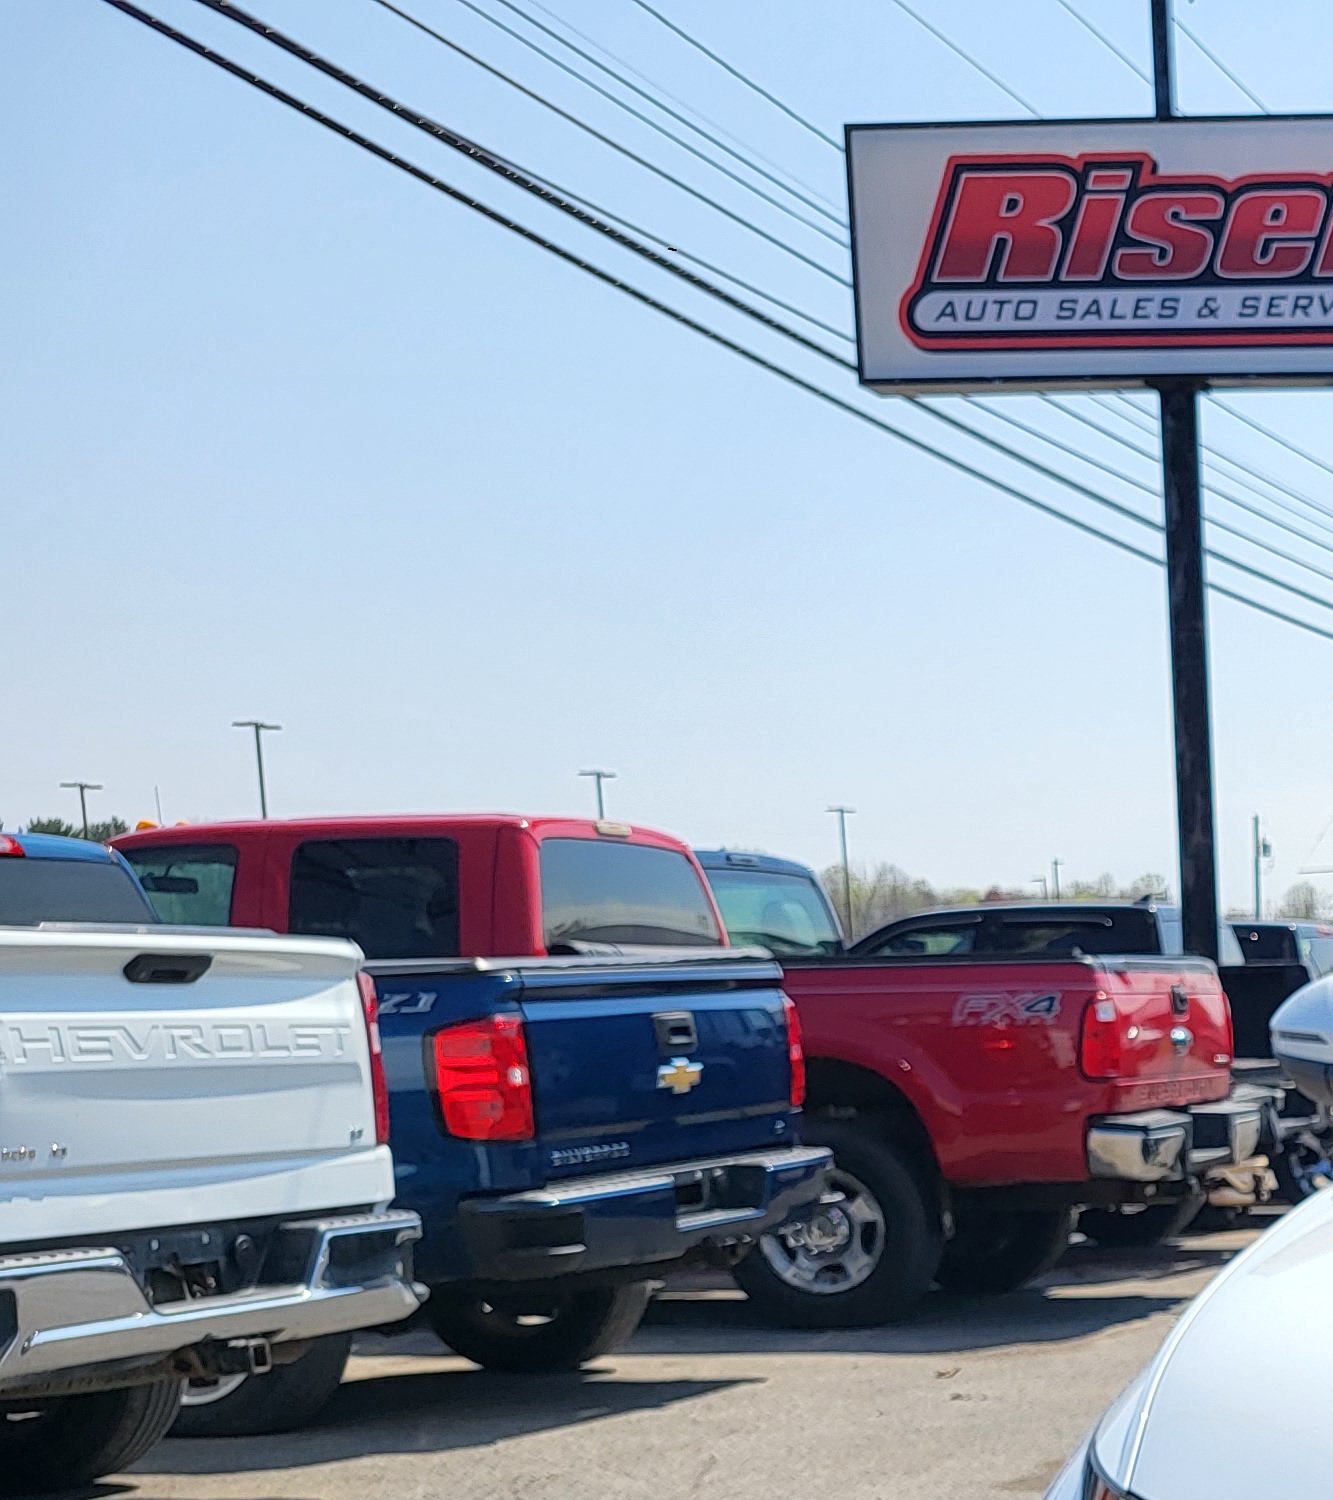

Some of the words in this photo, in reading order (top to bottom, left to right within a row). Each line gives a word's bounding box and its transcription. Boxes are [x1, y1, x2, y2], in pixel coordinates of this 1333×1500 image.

[935, 299, 1038, 322] AUTO
[1055, 297, 1179, 321] SALES
[1198, 295, 1223, 318] &
[953, 992, 1062, 1024] FX4
[0, 1023, 352, 1064] HEVROLET
